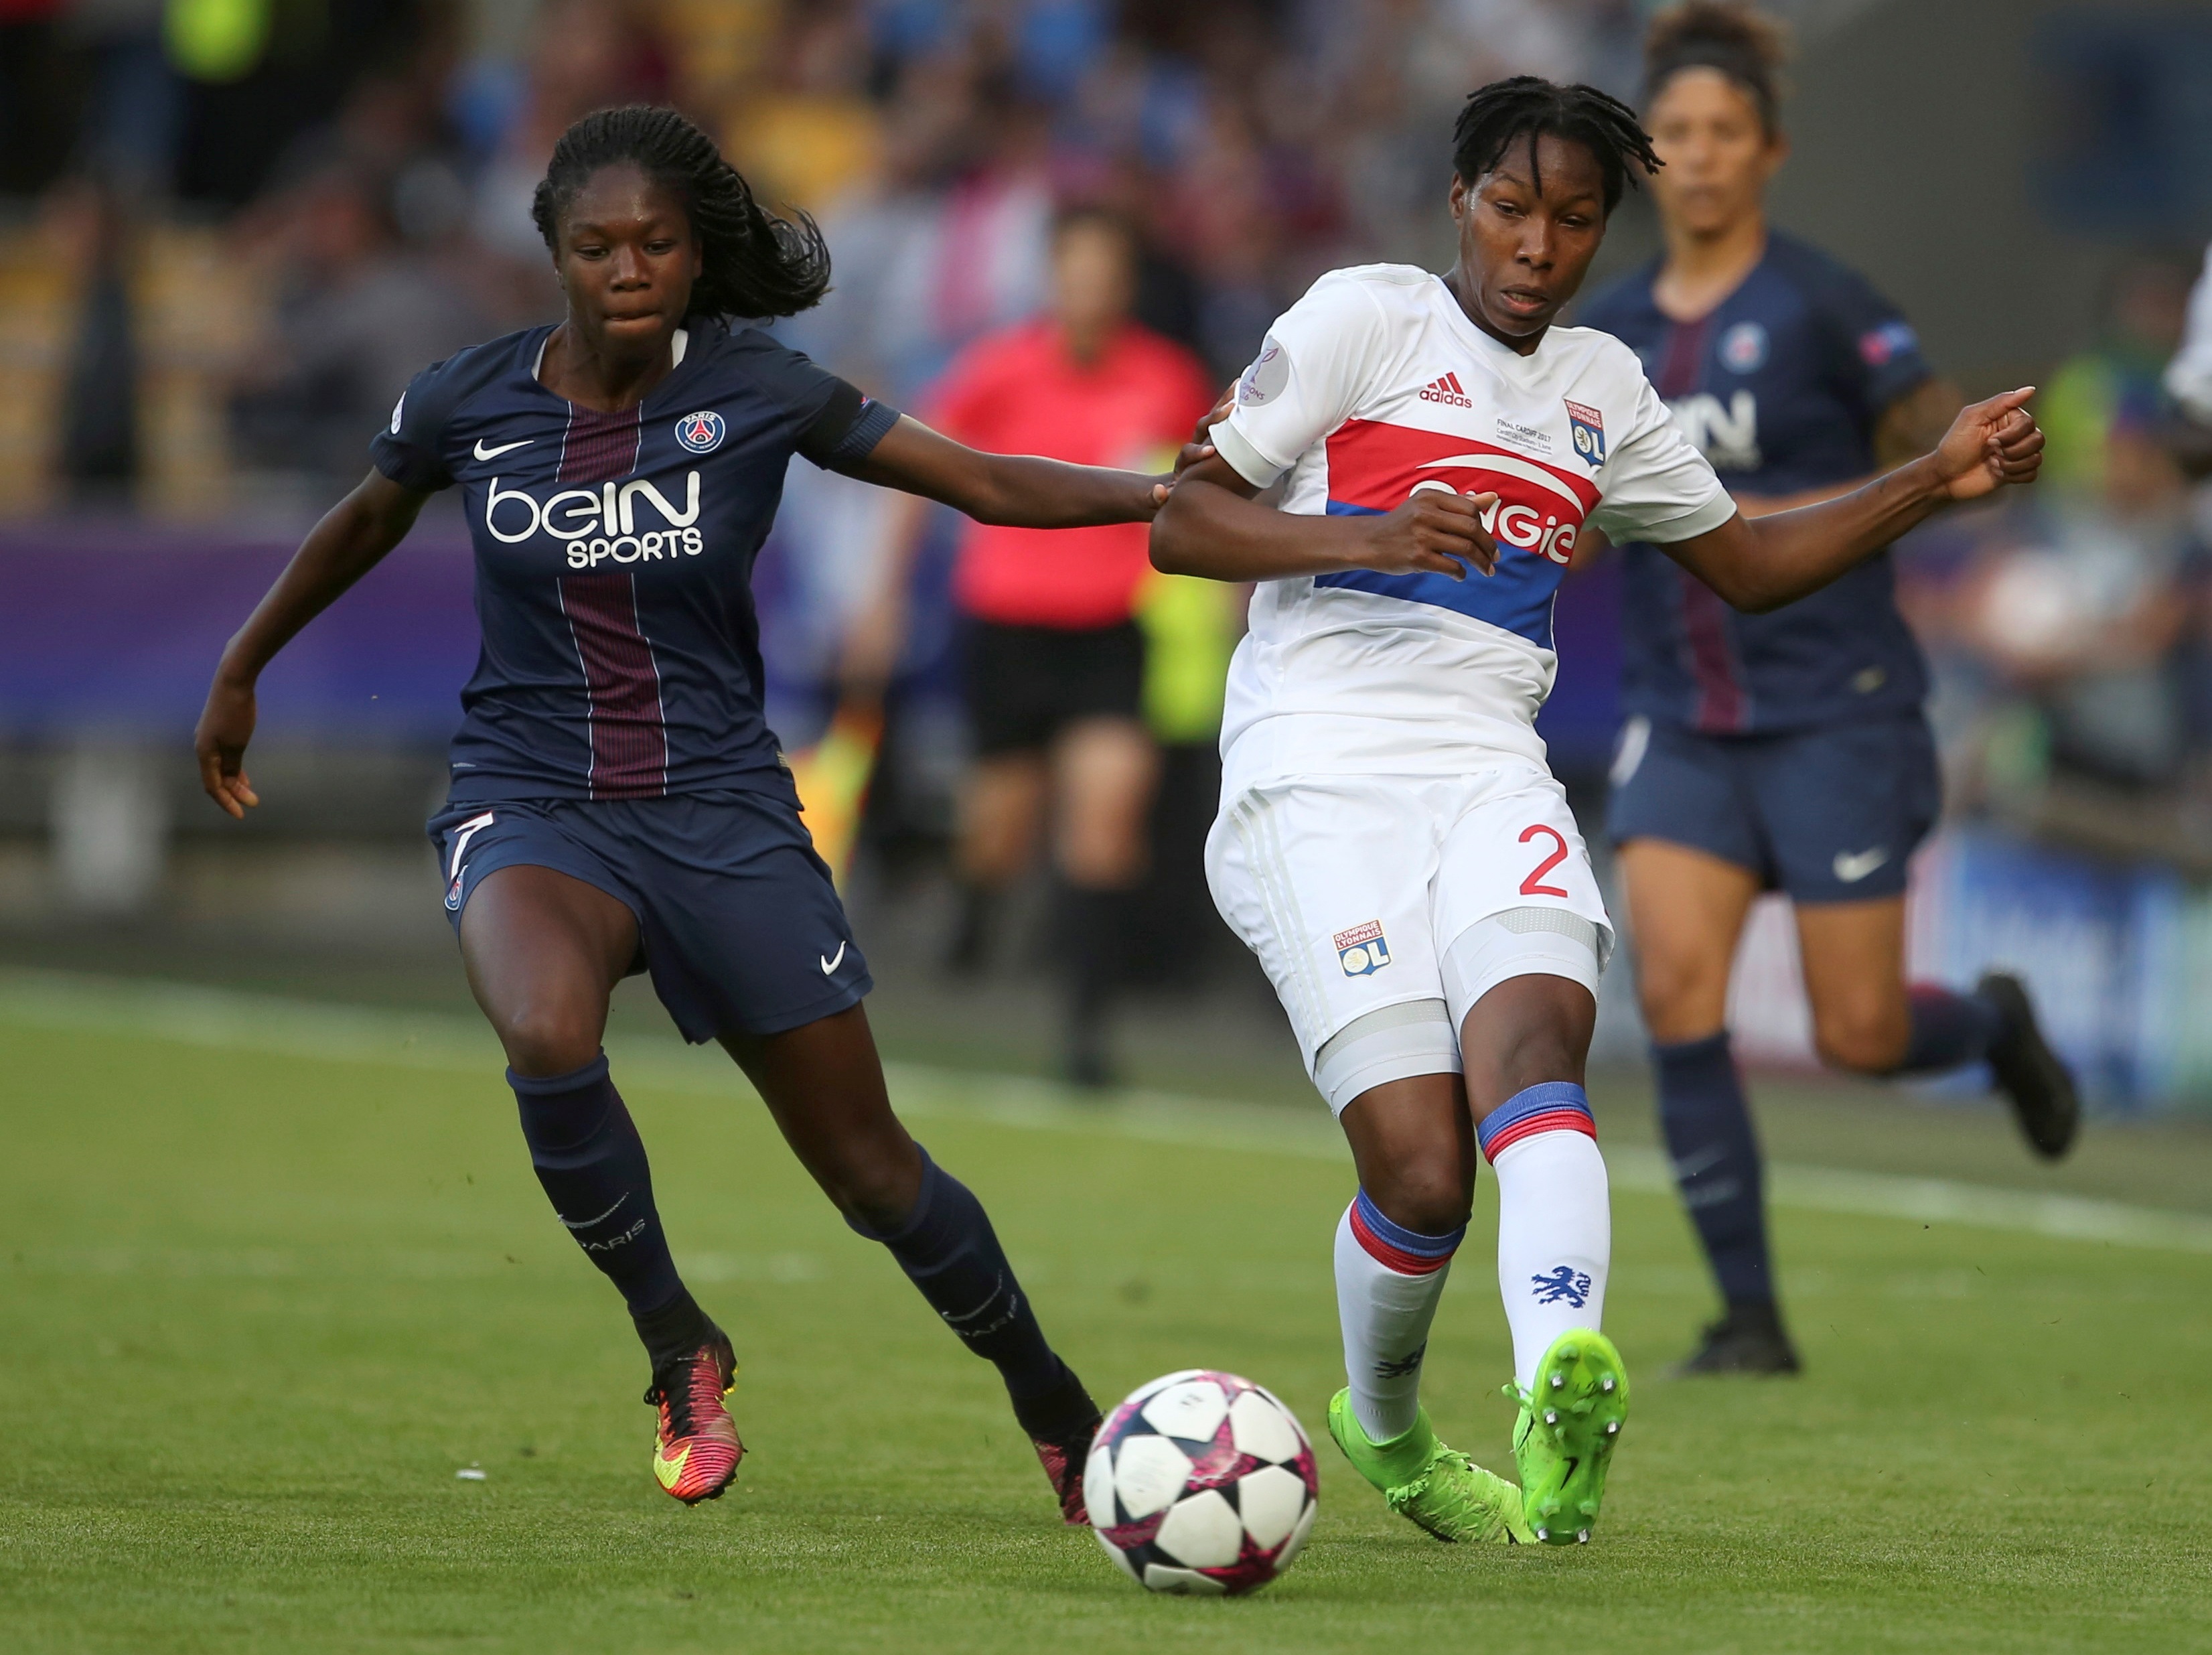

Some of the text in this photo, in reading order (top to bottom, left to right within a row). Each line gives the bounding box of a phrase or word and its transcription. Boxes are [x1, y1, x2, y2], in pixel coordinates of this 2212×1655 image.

[1419, 388, 1472, 409] adidas
[684, 413, 717, 423] PARIS
[1566, 401, 1601, 420] OLYMPIQUE
[1570, 409, 1602, 429] LYONNAIS
[1497, 418, 1552, 443] FINAL CARDIFF 2017
[566, 527, 703, 569] SPORTS
[450, 811, 494, 881] 7
[1518, 824, 1568, 898] 2
[1335, 921, 1380, 942] OLYMPIQUE
[1337, 928, 1382, 948] LYONNAIS
